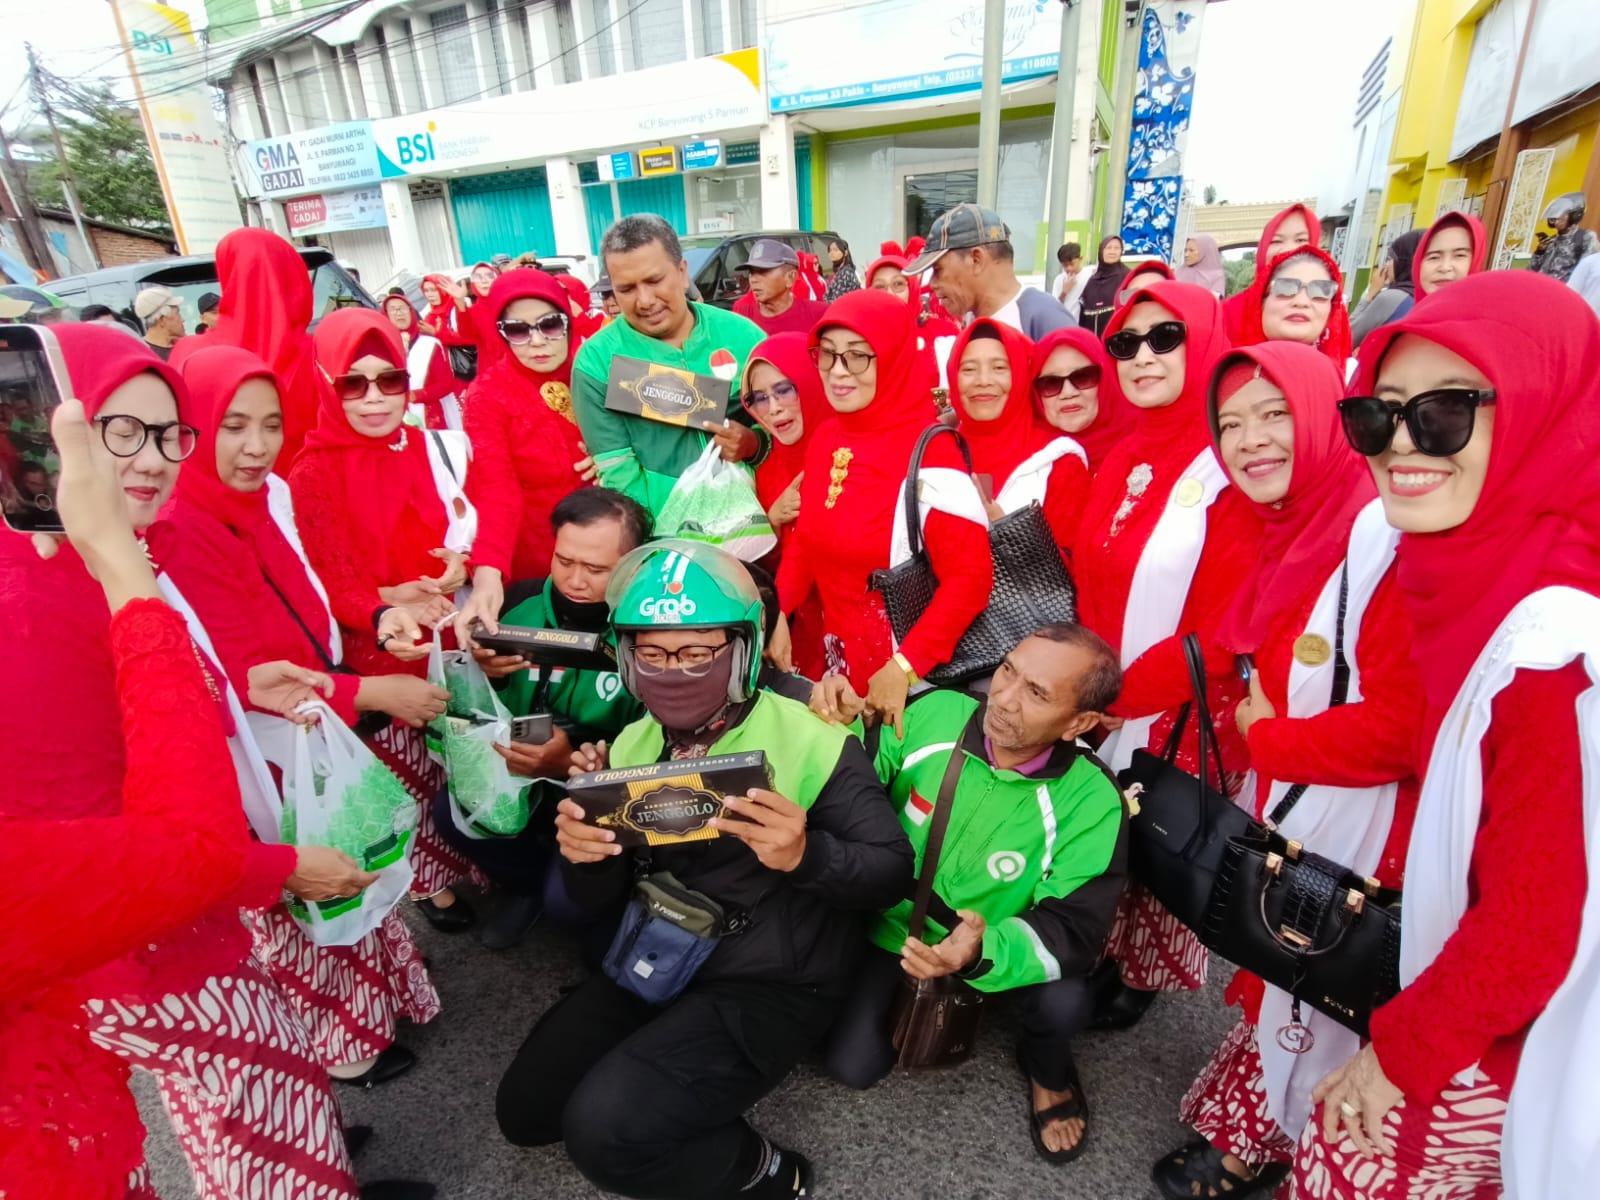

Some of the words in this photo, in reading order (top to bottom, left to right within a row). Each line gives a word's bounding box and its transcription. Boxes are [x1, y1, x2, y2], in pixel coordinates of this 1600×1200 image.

[132, 30, 172, 56] BSI
[716, 106, 749, 118] Parman
[345, 128, 367, 139] ARTHA
[256, 142, 300, 171] GMA
[396, 131, 436, 165] BSI
[263, 169, 304, 190] GADAI
[288, 199, 321, 212] TERIMA
[294, 212, 320, 224] GADAI
[643, 386, 692, 406] JENGGOLO
[640, 593, 697, 617] Grab
[534, 631, 579, 645] JENGGOLO
[594, 765, 661, 783] JENGGOLO
[636, 802, 714, 824] JENGGOLO
